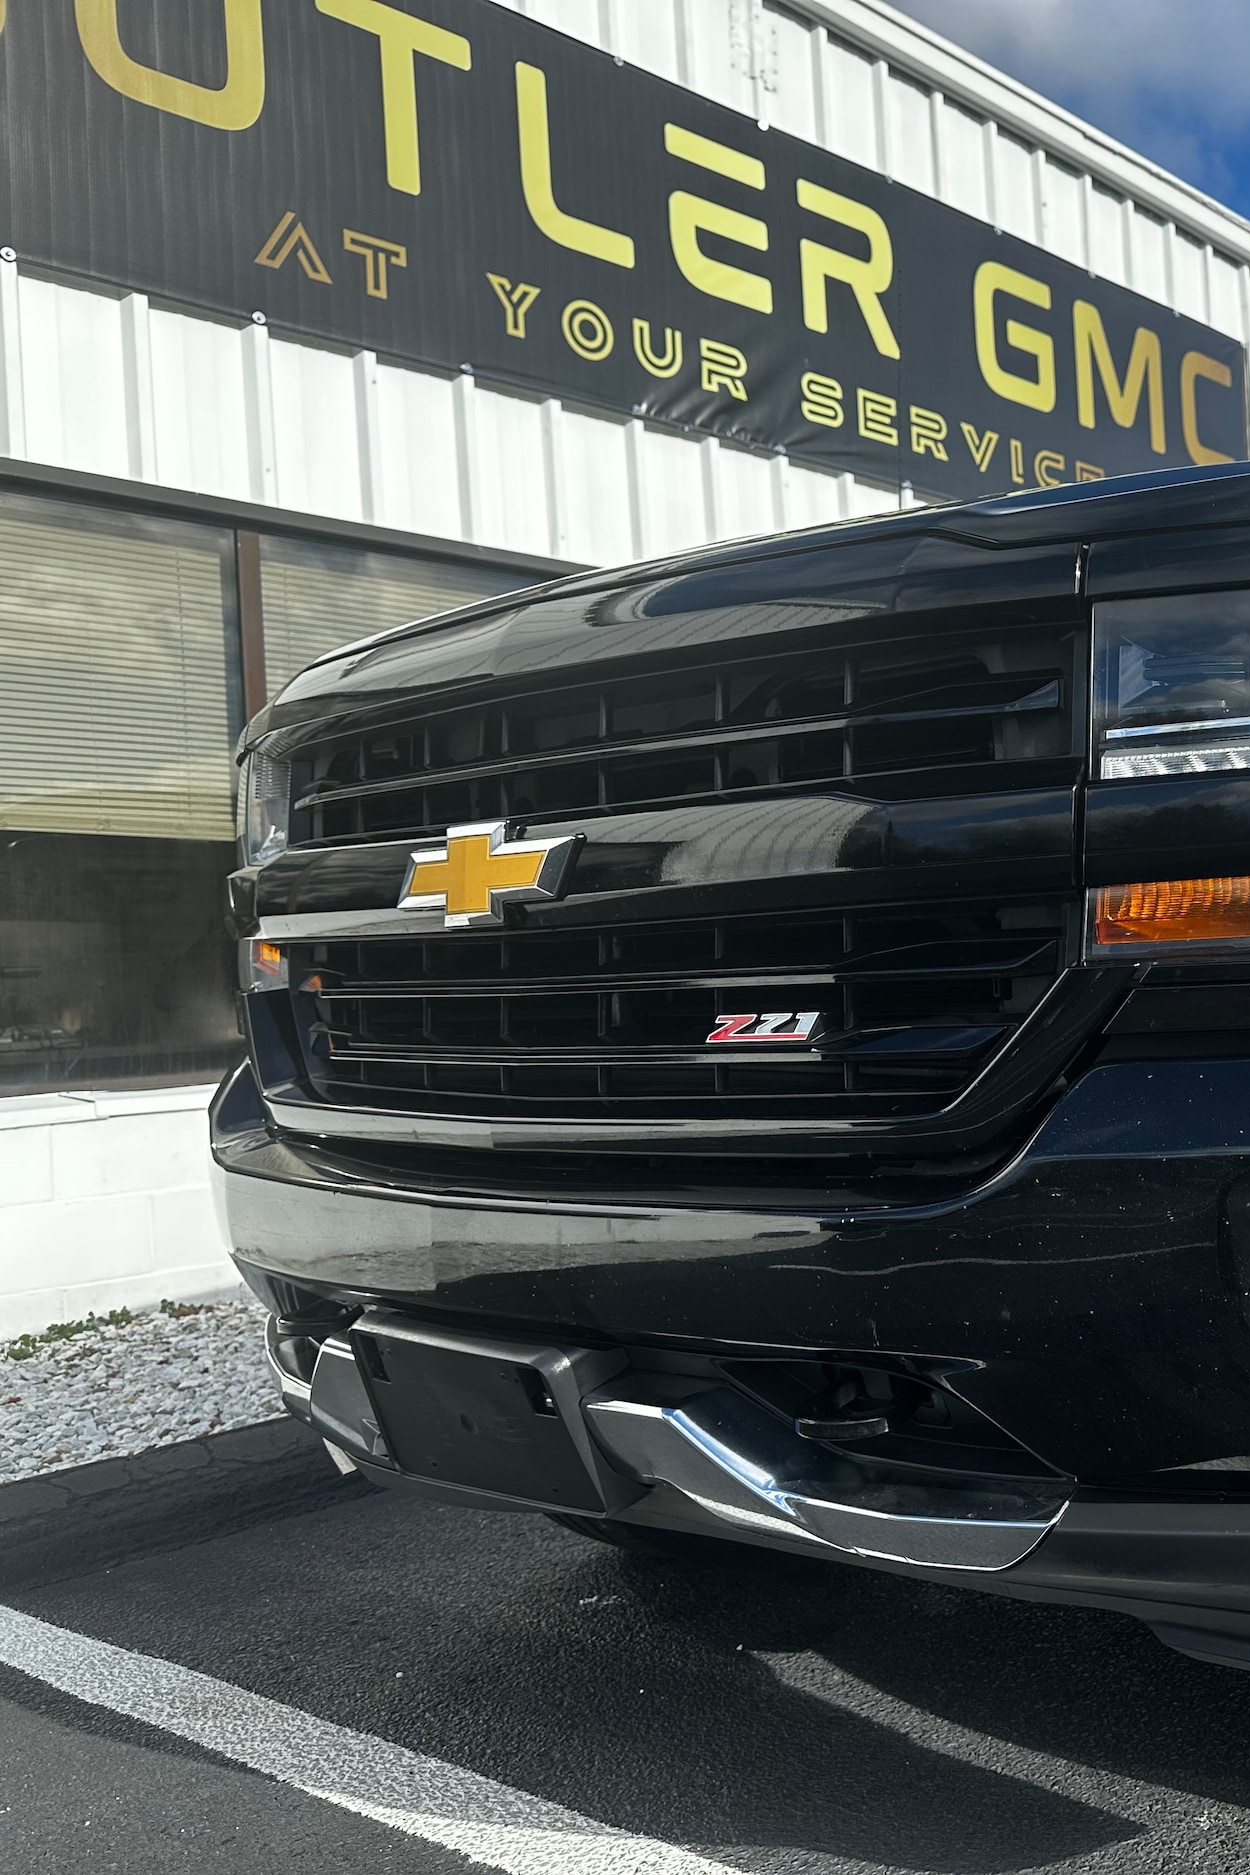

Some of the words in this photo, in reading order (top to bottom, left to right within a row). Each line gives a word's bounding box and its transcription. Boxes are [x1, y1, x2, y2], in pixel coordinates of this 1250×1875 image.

[0, 0, 900, 360] UTLER
[973, 261, 1235, 466] GMC
[254, 211, 407, 300] AT
[486, 272, 748, 402] YOUR
[705, 1012, 820, 1043] Z71
